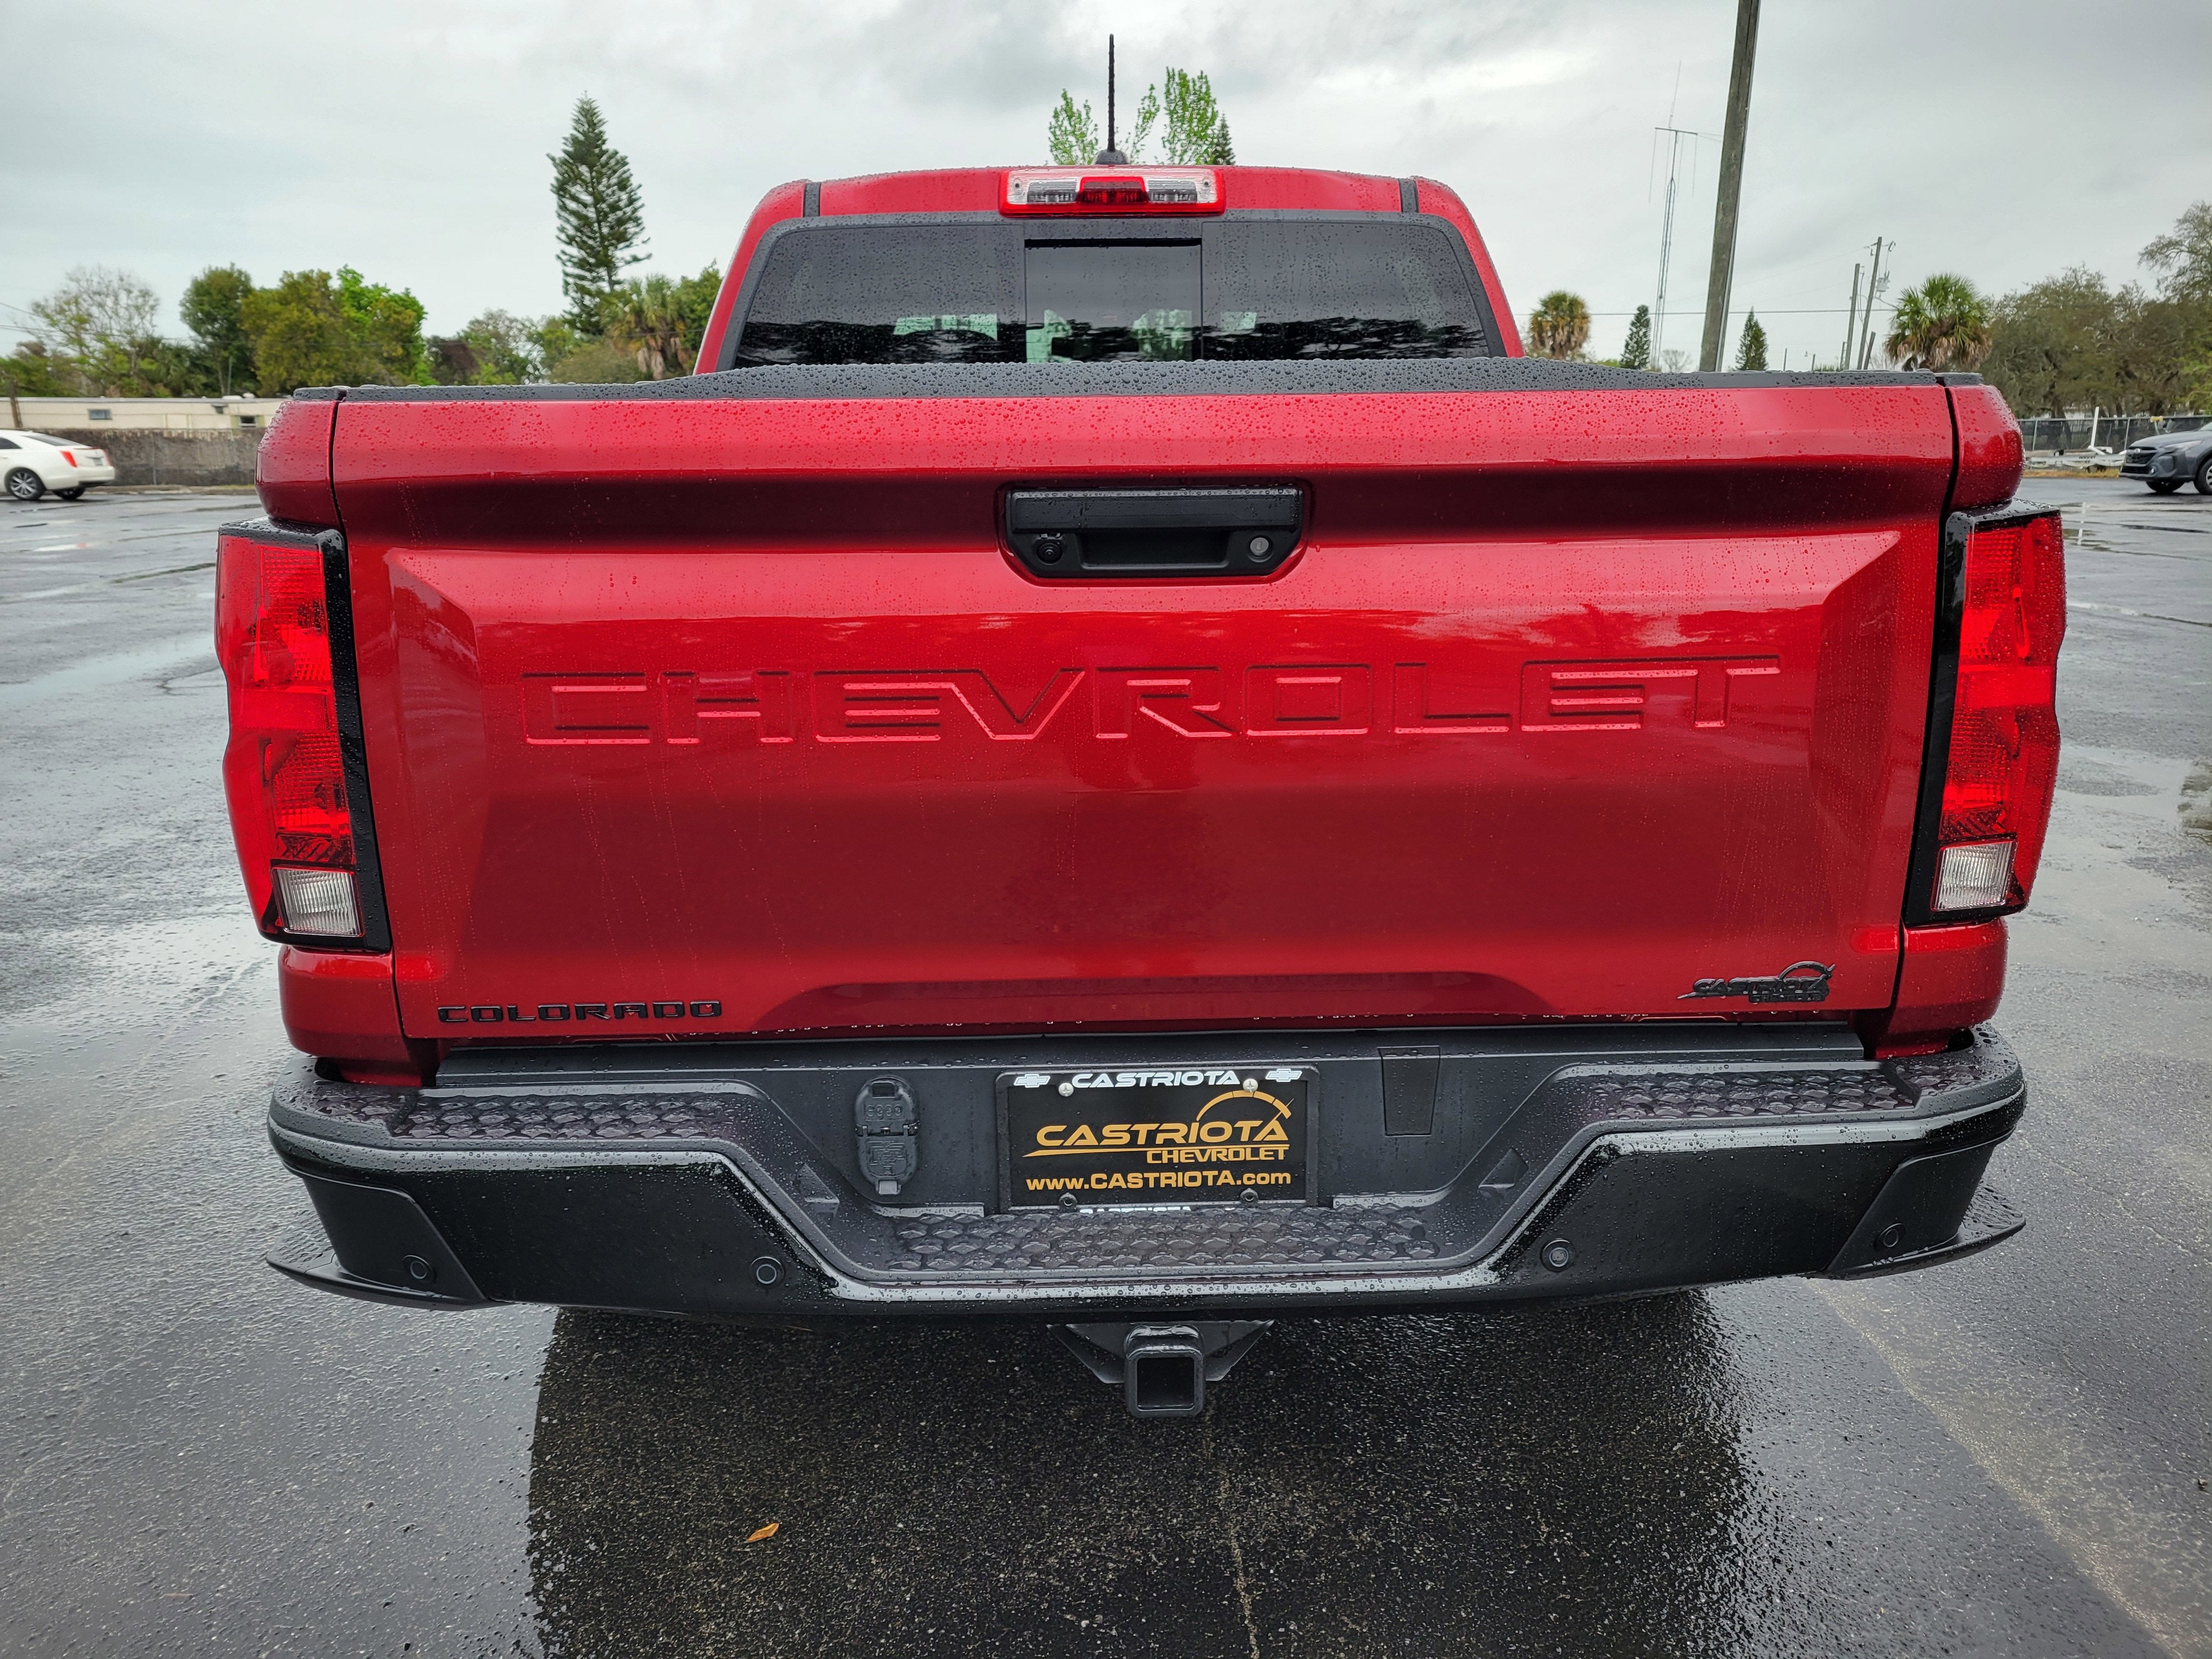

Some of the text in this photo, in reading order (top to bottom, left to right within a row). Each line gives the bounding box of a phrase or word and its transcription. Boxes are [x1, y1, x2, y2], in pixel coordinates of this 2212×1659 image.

[522, 655, 1781, 743] CHEVROLET
[438, 1001, 723, 1023] COLORADO
[1071, 1071, 1240, 1088] CASTRIOTA
[1036, 1121, 1289, 1147] CASTRIOTA
[1147, 1147, 1287, 1164] CHEVROLET
[1026, 1170, 1291, 1190] www.CASTRIOTA.com
